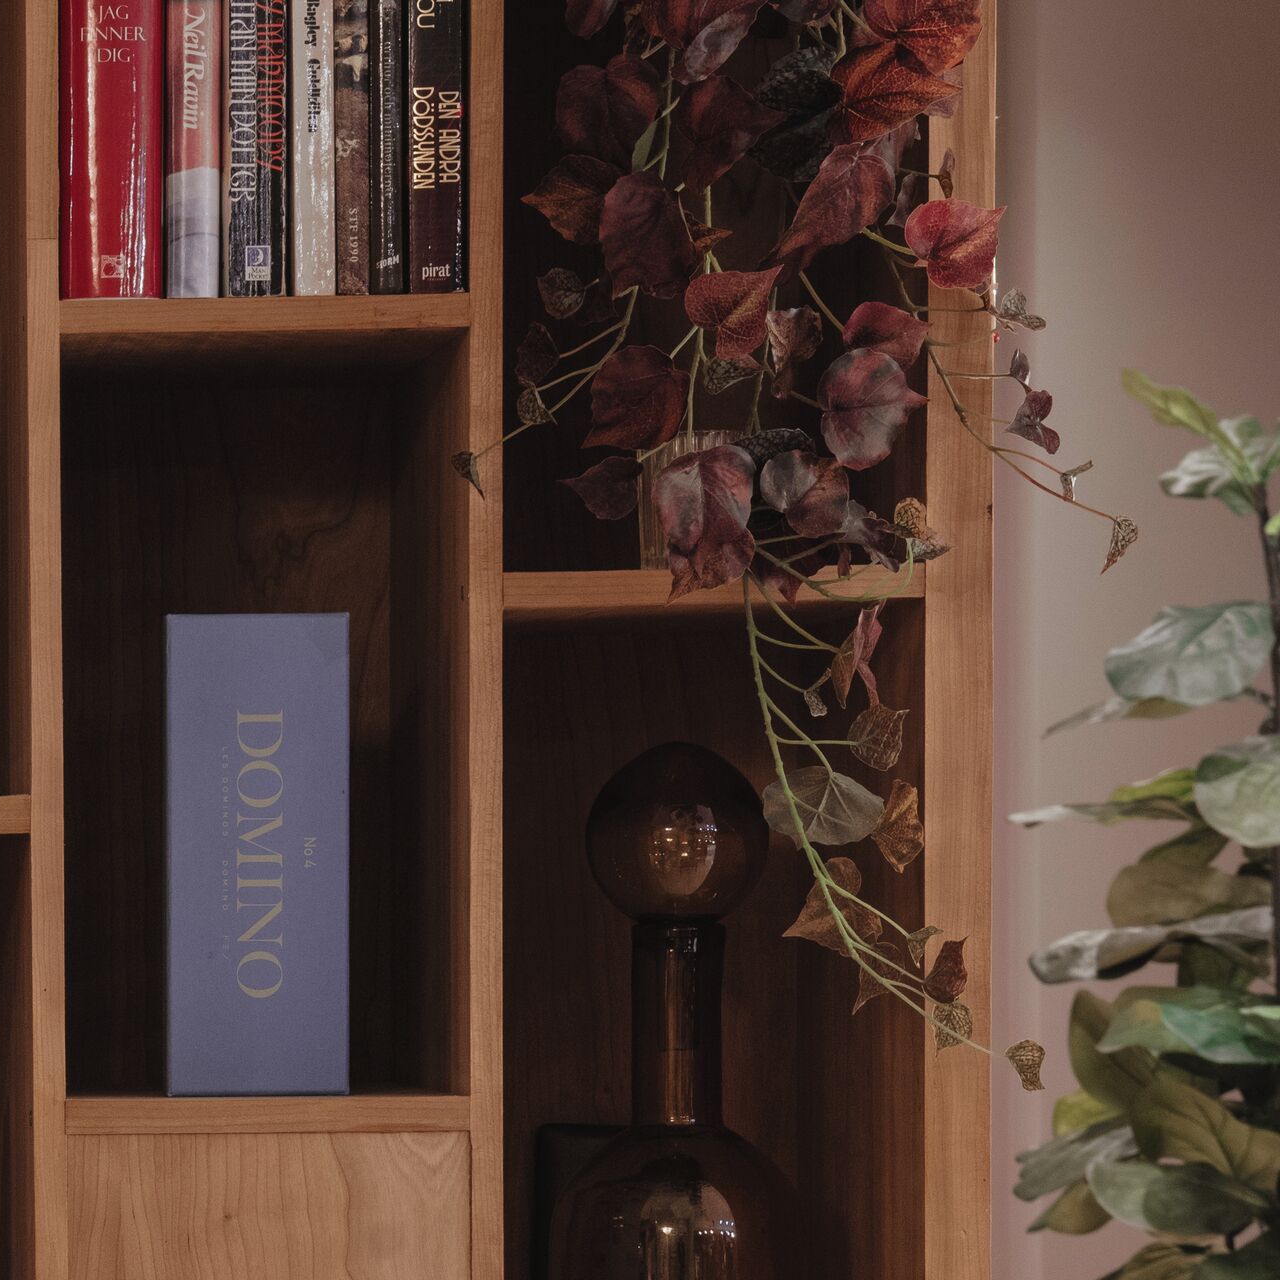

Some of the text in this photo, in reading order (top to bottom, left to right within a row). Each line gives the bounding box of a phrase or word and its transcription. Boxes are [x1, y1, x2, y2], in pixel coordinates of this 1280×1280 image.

[98, 4, 129, 24] JAG
[304, 0, 321, 46] Bagley
[97, 47, 130, 63] DIG
[183, 8, 207, 130] Neil Ravin
[412, 86, 435, 189] DÖDSSYNDEN
[437, 91, 461, 183] DEN ANDRA
[348, 207, 359, 263] STF 1990
[421, 262, 452, 281] pirat
[236, 709, 284, 999] DOMINO
